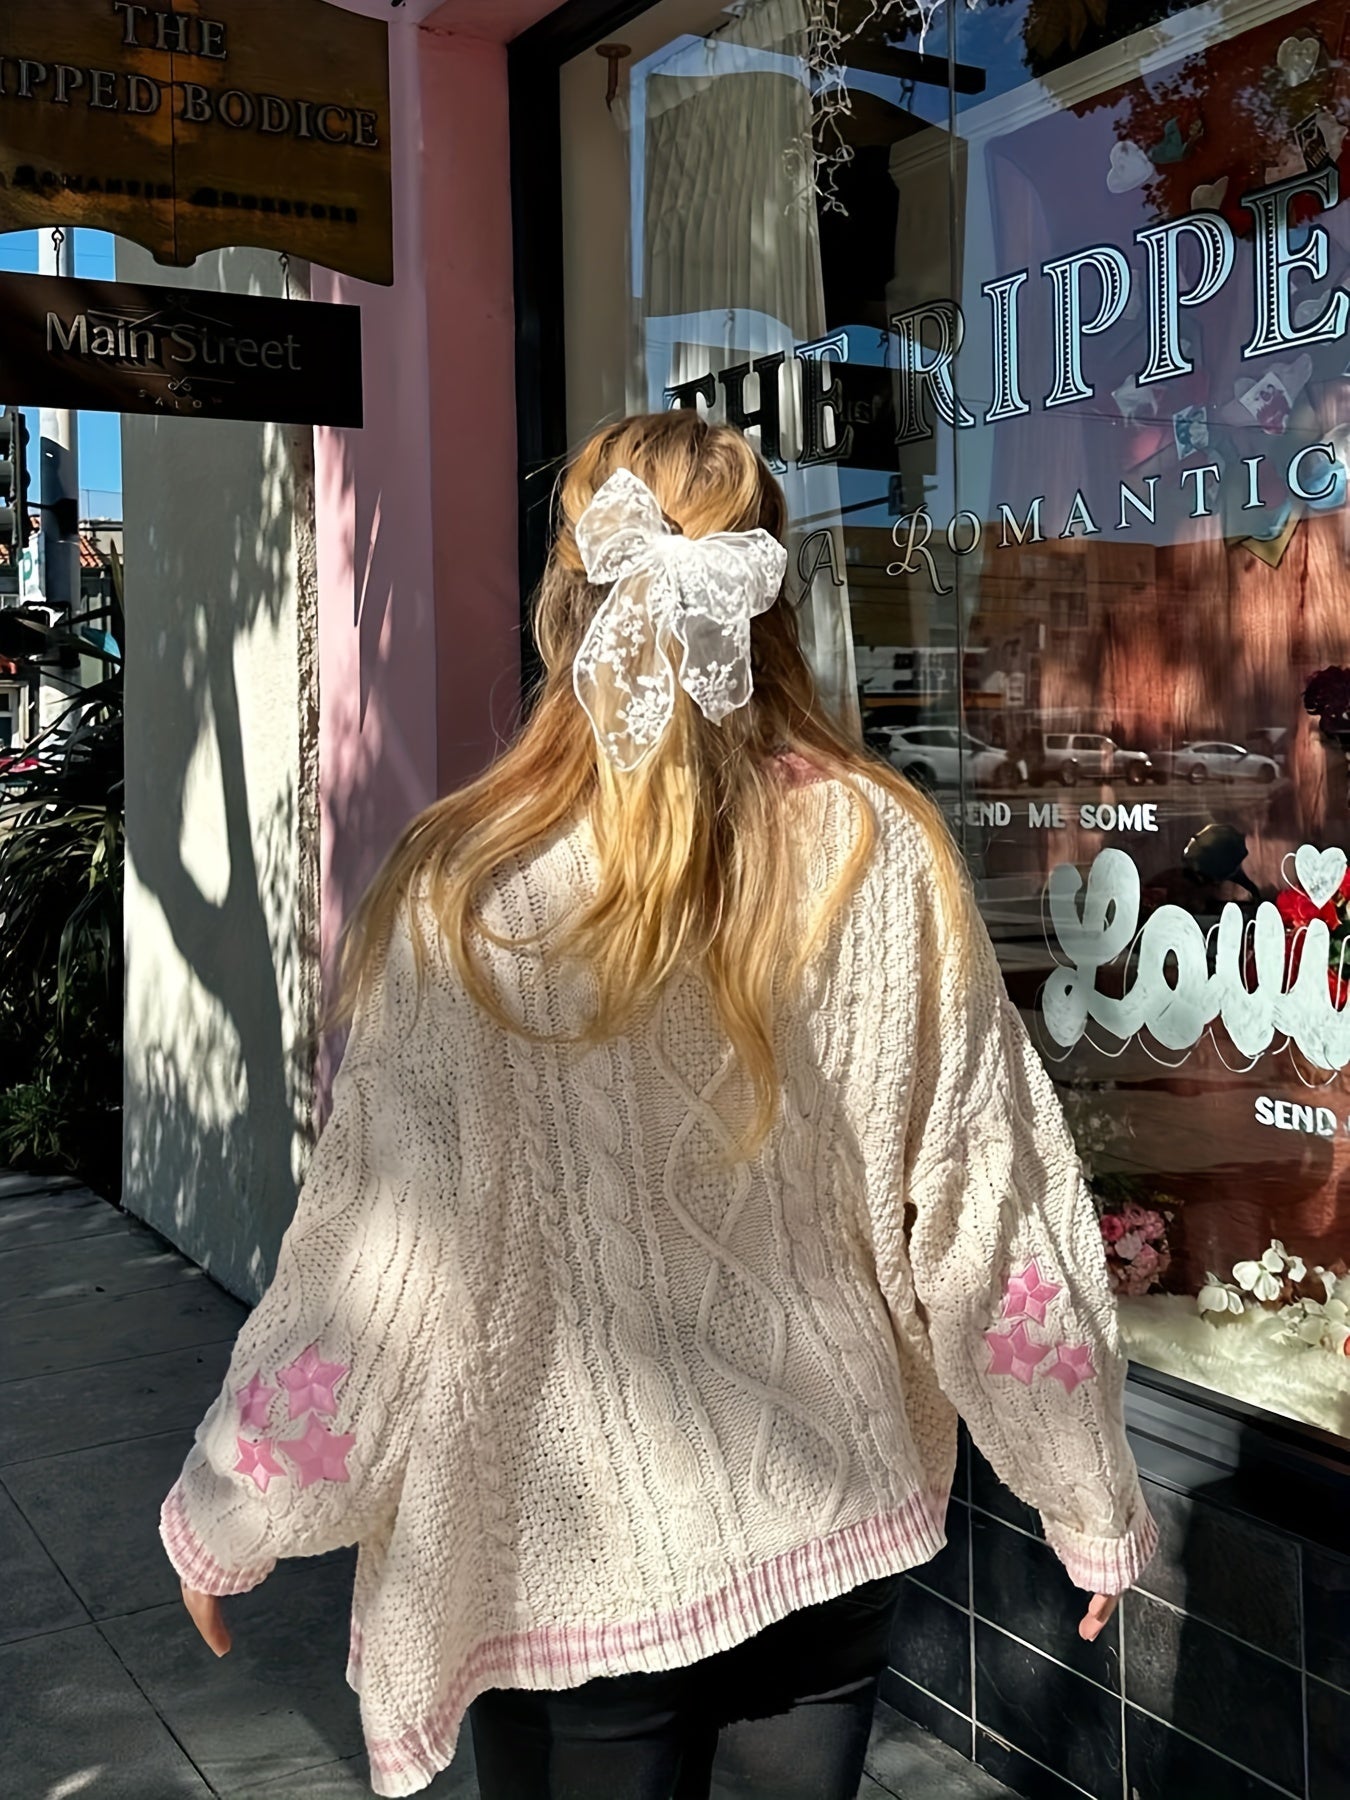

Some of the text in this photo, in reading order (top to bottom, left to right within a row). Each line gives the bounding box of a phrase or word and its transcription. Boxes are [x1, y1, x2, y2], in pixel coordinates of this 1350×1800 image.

[114, 1, 228, 60] THE
[183, 82, 379, 147] BODICE
[889, 166, 1350, 446] RIPPE
[46, 312, 302, 371] Main Street
[795, 442, 1338, 608] A ROMANTIC
[1028, 802, 1066, 828] ME
[1079, 803, 1160, 832] SOME
[1254, 1096, 1337, 1136] SEND
